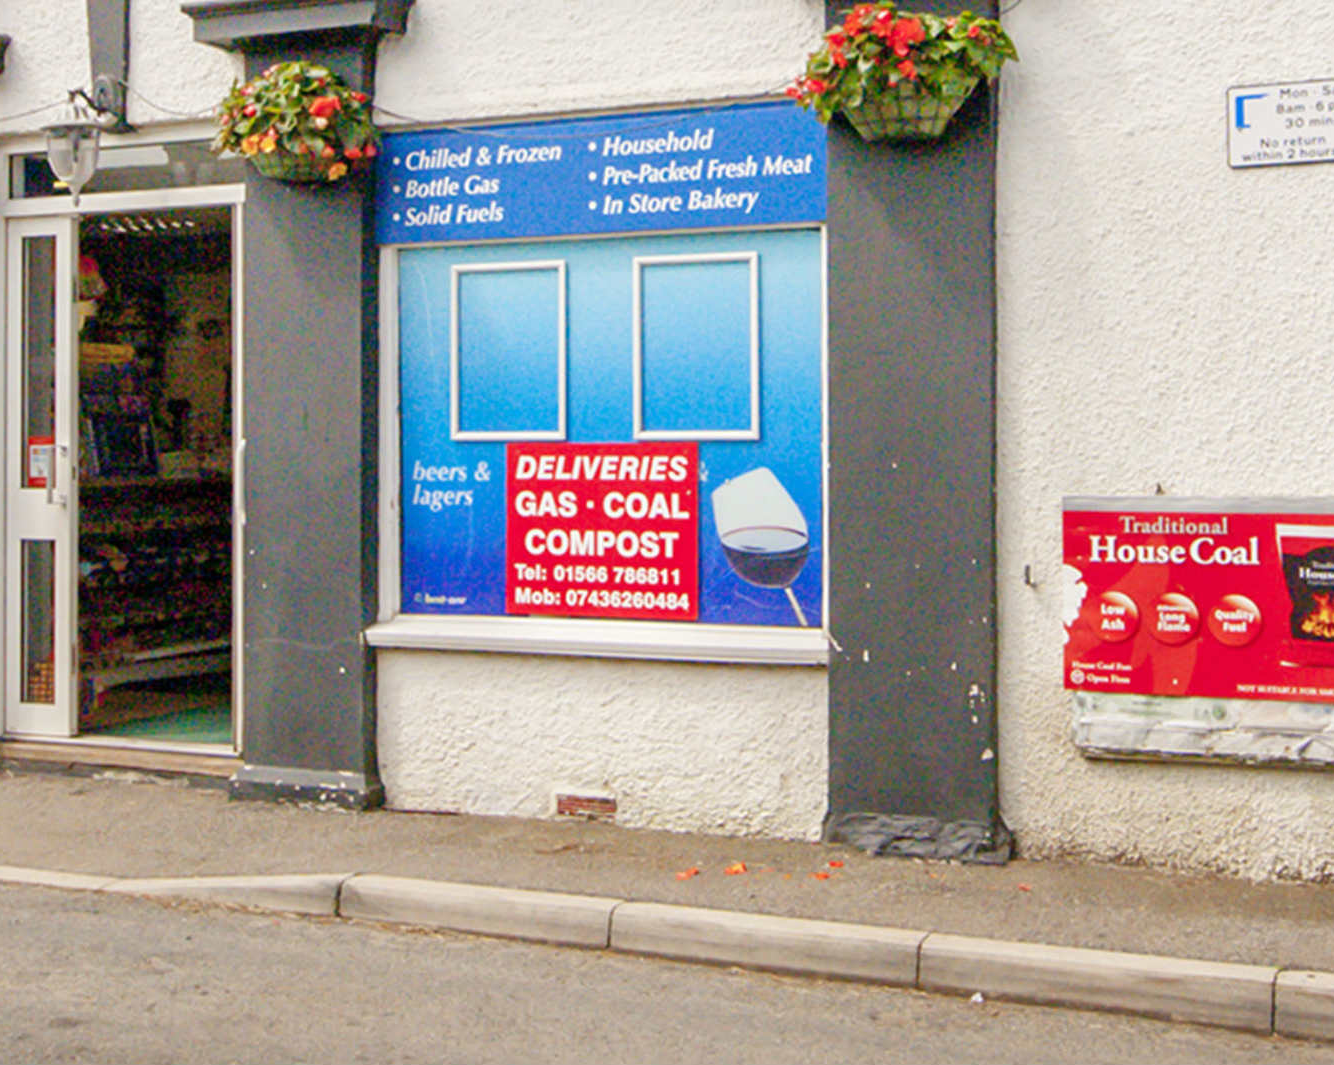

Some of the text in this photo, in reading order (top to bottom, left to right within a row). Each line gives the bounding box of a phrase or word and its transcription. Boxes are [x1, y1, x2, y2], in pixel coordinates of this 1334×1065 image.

[1279, 88, 1309, 99] Mon
[602, 128, 714, 156] Household
[1260, 136, 1326, 149] No return
[405, 145, 562, 171] Chilled & Frozen
[1242, 151, 1283, 161] within
[1287, 149, 1296, 159] 2
[602, 154, 813, 185] Pre-Packed Fresh Meat
[405, 175, 500, 198] Bottle Gas
[602, 188, 759, 215] In Store Bakery
[405, 200, 504, 226] Solid Fuels
[412, 460, 491, 482] beers &
[516, 455, 689, 482] DELIVERIES
[412, 486, 475, 513] lagers
[515, 490, 690, 519] GAS COAL
[1119, 515, 1228, 535] Traditional
[525, 529, 680, 559] COMPOST
[1089, 536, 1260, 565] House Coal
[515, 563, 681, 585] Tel: 01566 786811
[515, 587, 690, 611] Mob: 07436260484
[1100, 603, 1125, 616] Low
[1101, 619, 1125, 631] Ash
[1157, 621, 1191, 633] Flame
[1159, 612, 1186, 624] Long
[1214, 610, 1255, 624] Quality
[1223, 622, 1247, 633] Fuel
